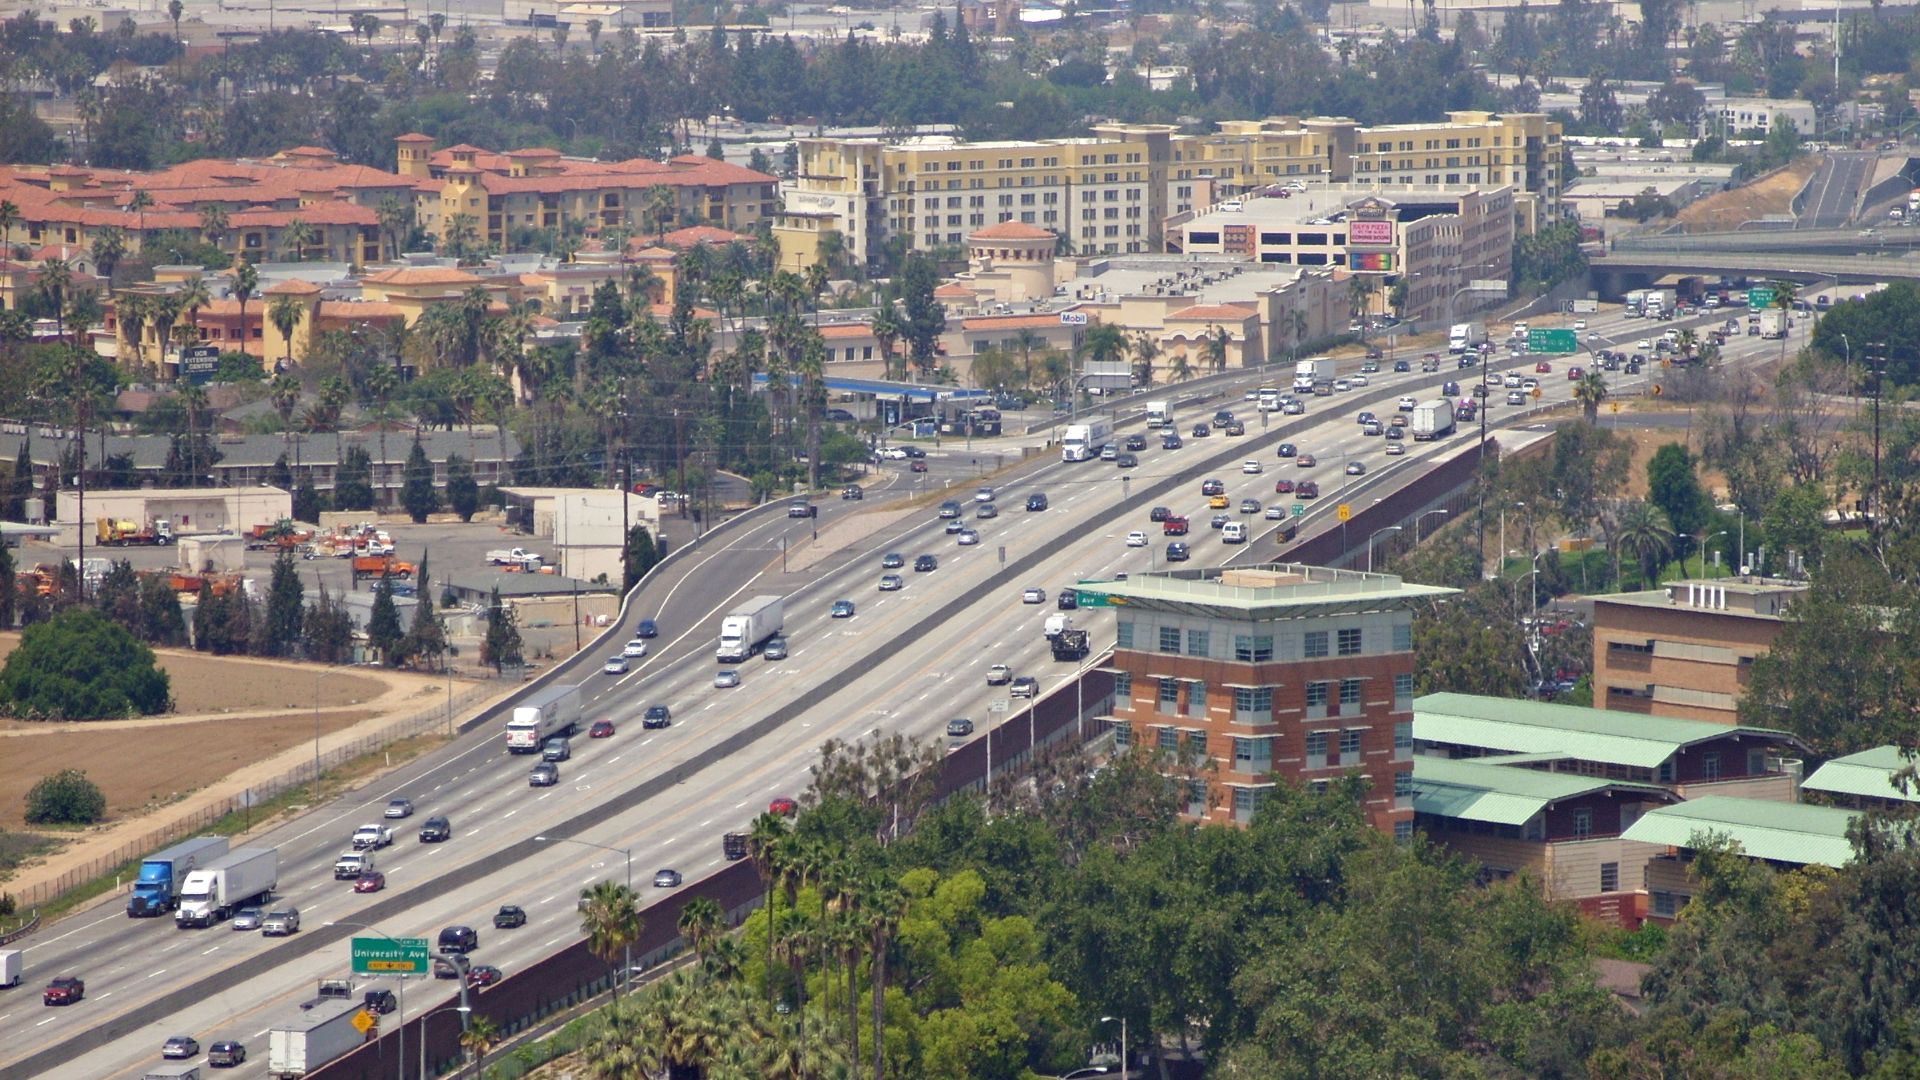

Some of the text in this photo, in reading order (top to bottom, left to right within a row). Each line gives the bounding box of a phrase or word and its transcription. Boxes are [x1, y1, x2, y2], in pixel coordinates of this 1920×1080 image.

[1062, 314, 1085, 322] Mobil
[184, 356, 218, 364] EXTENSION
[188, 362, 213, 370] CENTER
[354, 949, 425, 958] University Ave
